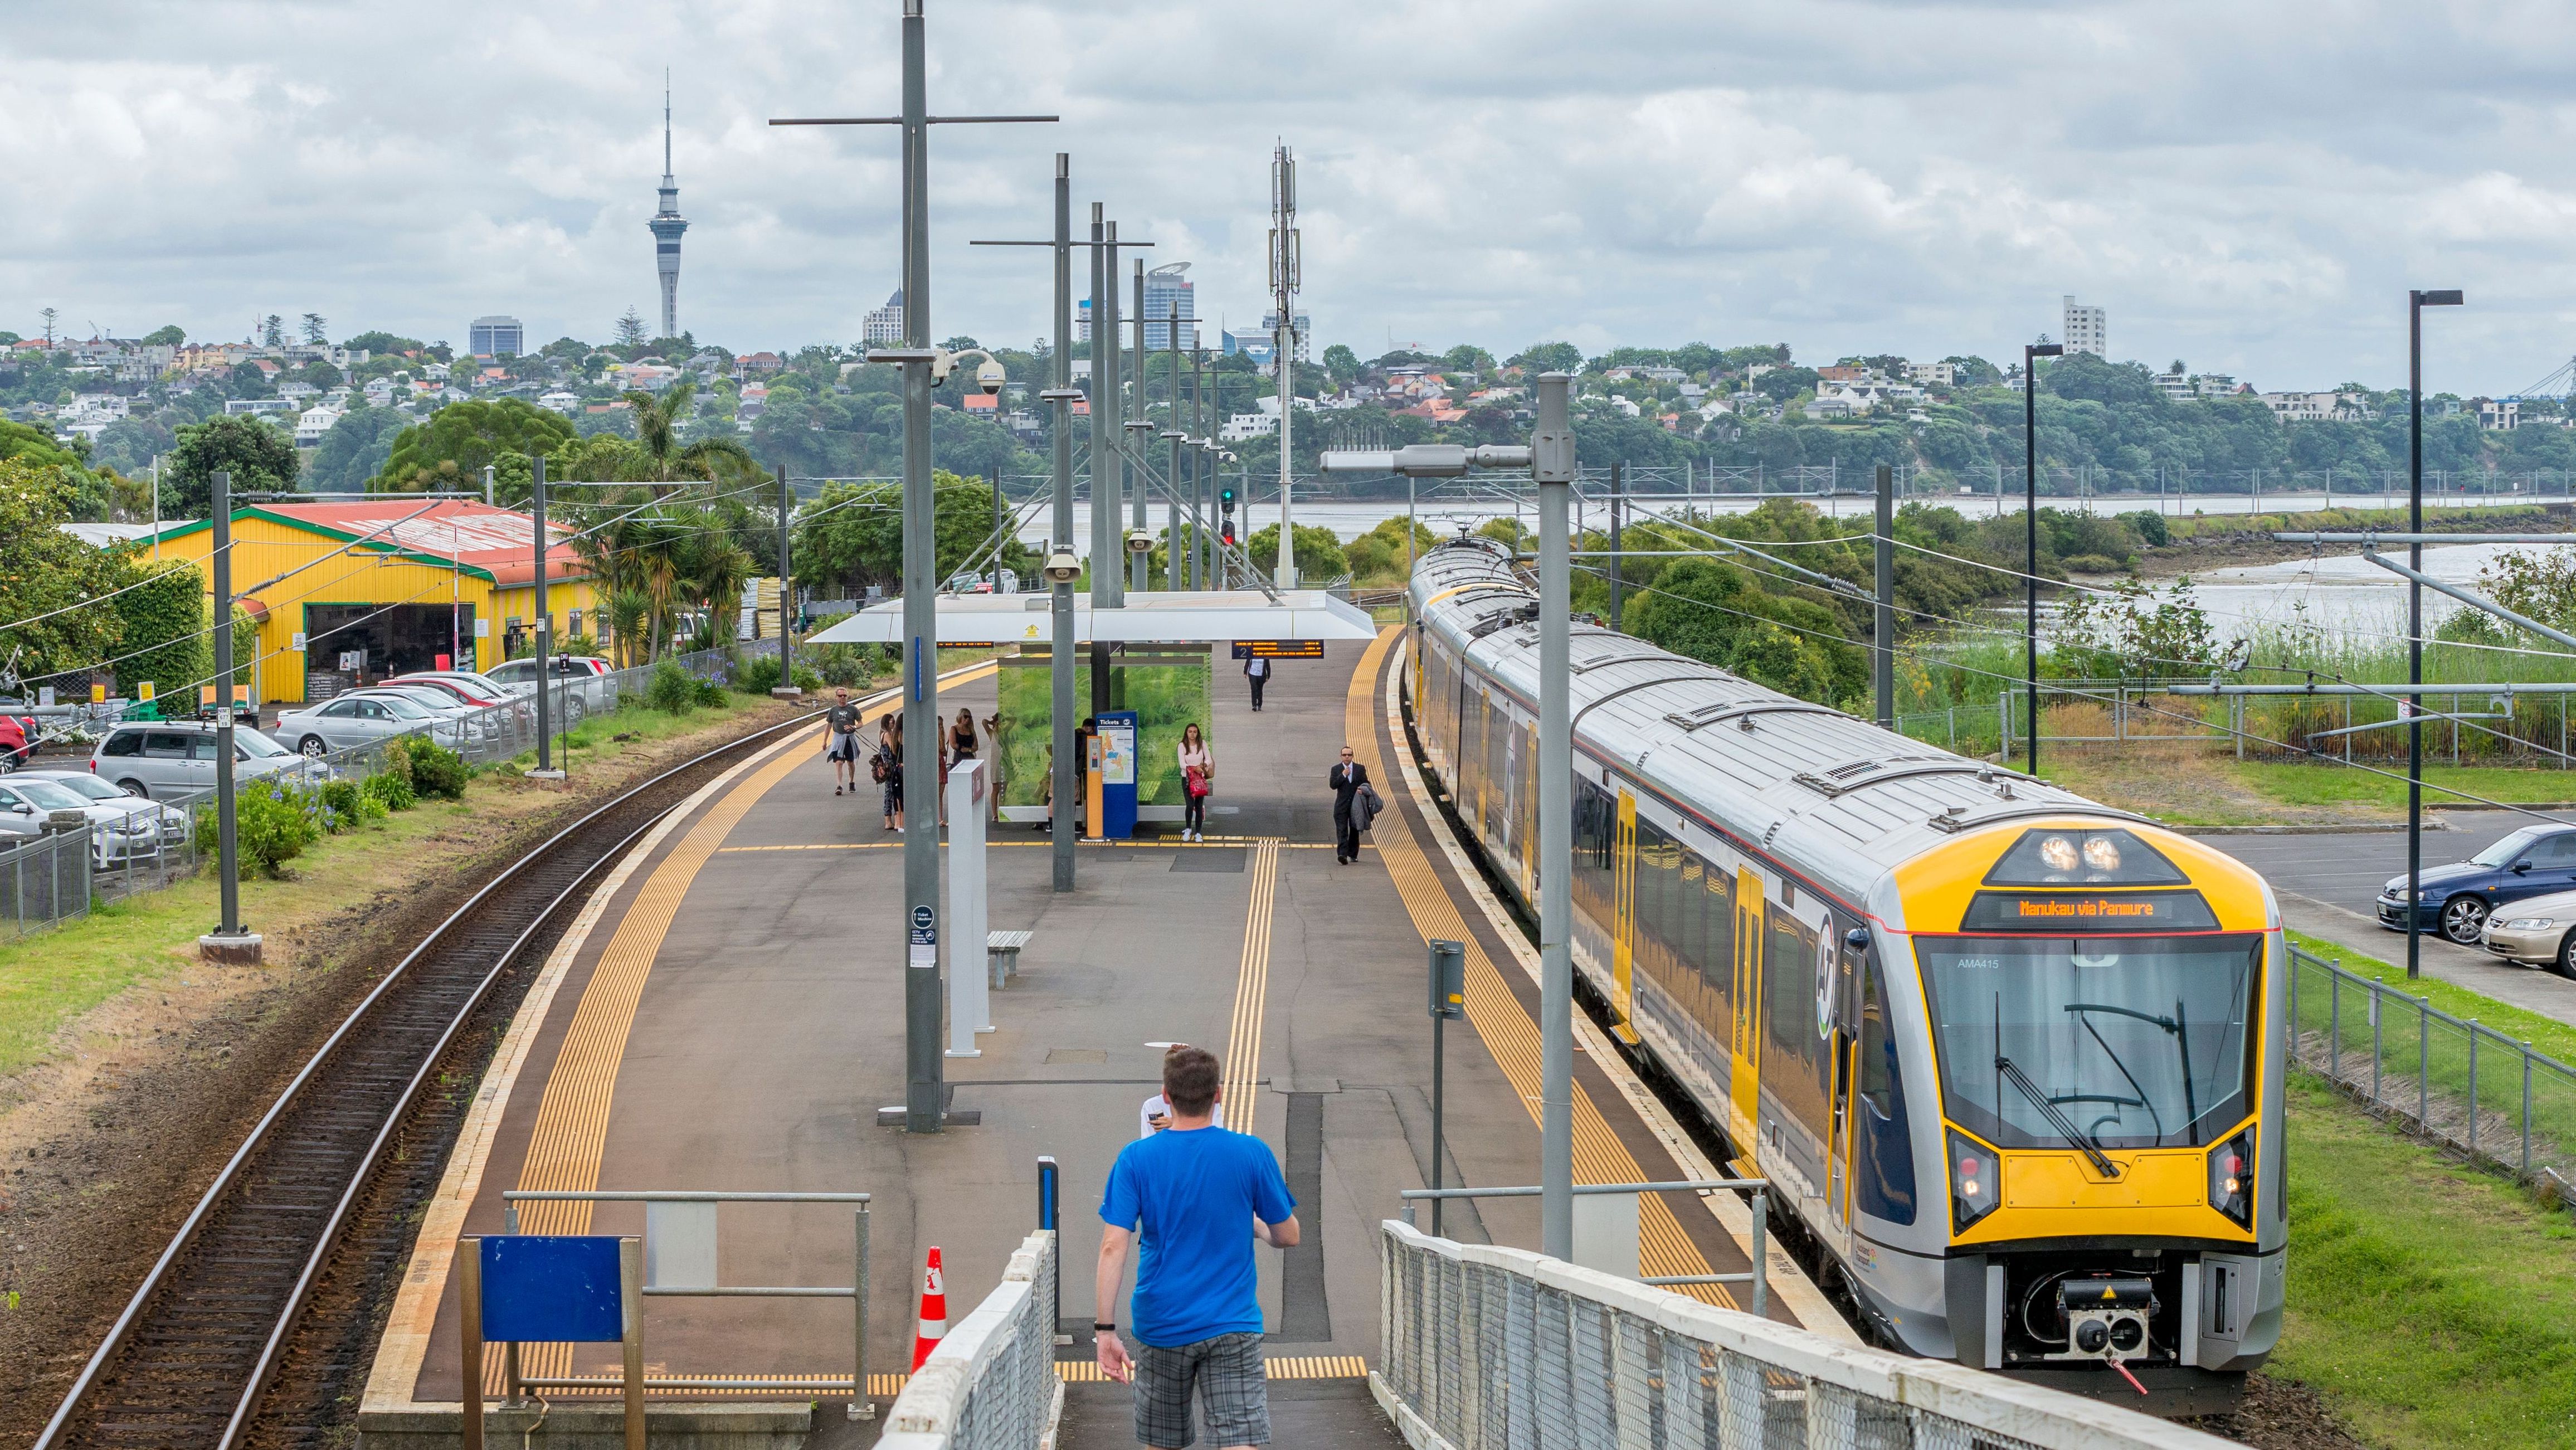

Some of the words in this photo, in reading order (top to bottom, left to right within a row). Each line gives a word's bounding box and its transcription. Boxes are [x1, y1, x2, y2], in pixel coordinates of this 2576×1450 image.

[1240, 648, 1247, 658] 2
[2019, 900, 2075, 916] Manukau
[2077, 900, 2096, 916] via
[2098, 900, 2154, 916] Panmure
[1957, 958, 1999, 969] AMA415
